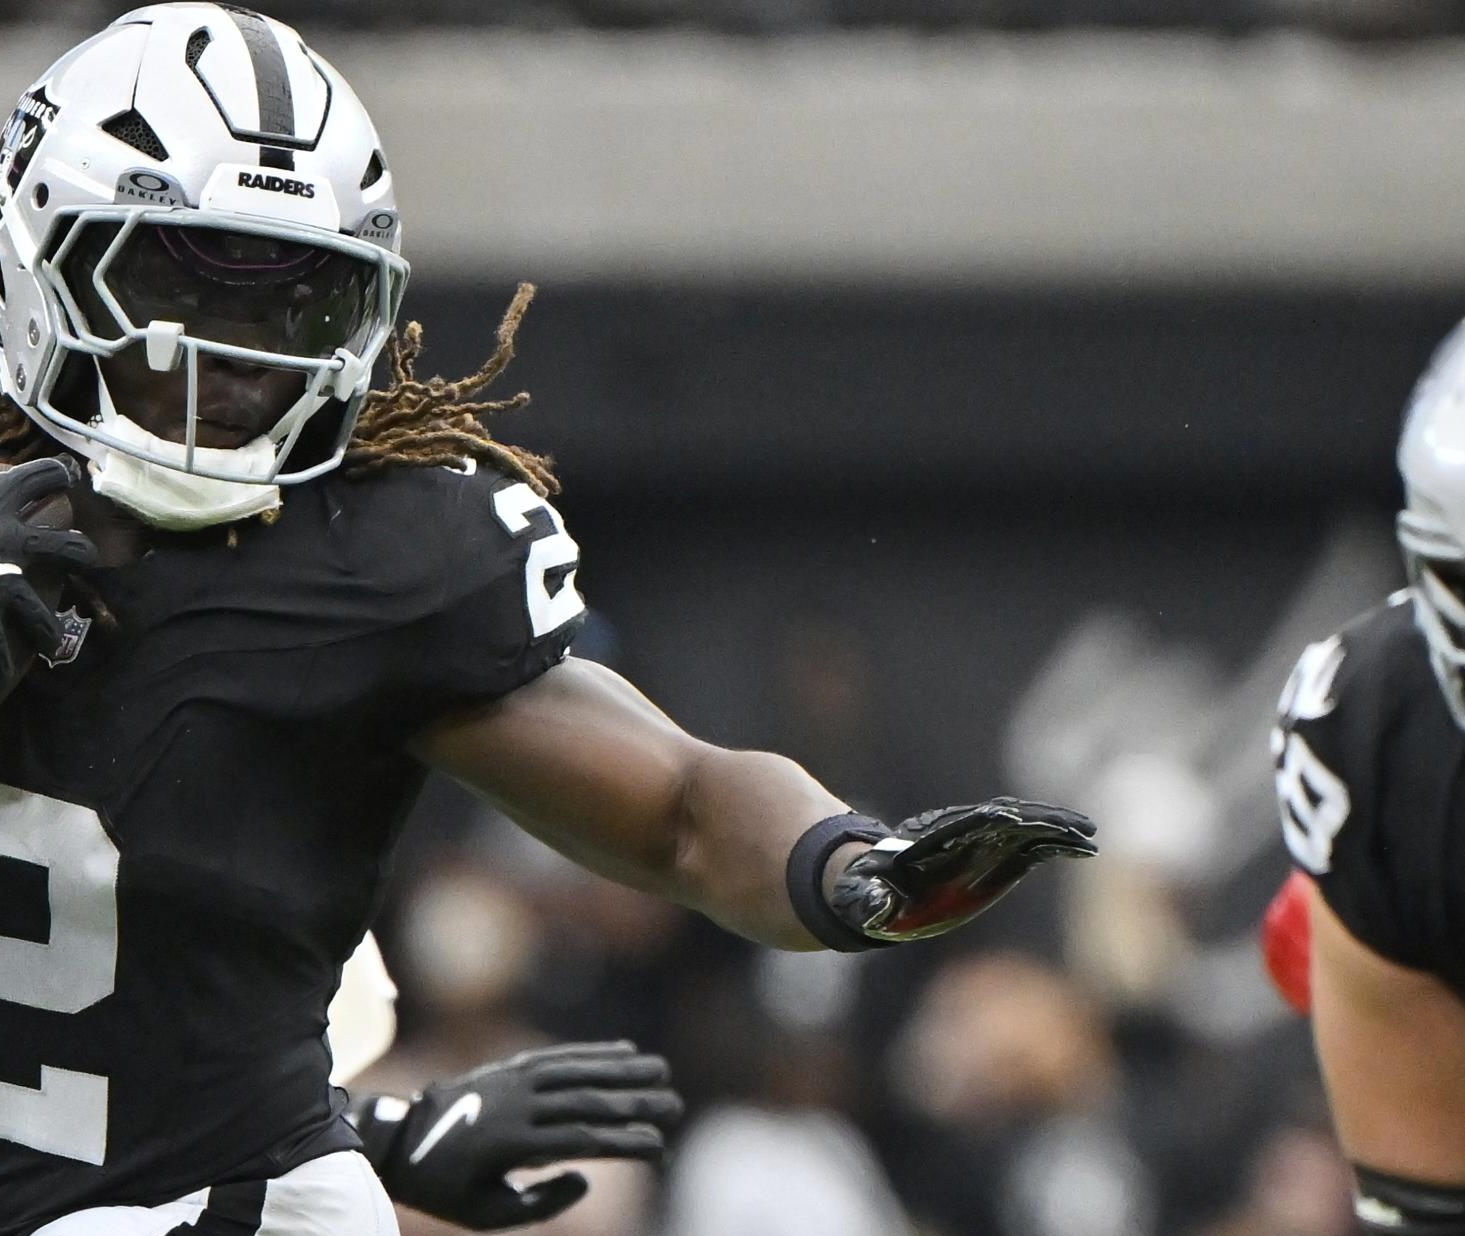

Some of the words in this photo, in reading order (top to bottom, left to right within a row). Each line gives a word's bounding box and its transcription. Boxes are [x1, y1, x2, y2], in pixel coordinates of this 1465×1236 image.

[116, 184, 178, 207] OAKLEY
[238, 171, 315, 199] RAIDERS
[493, 482, 587, 638] 2
